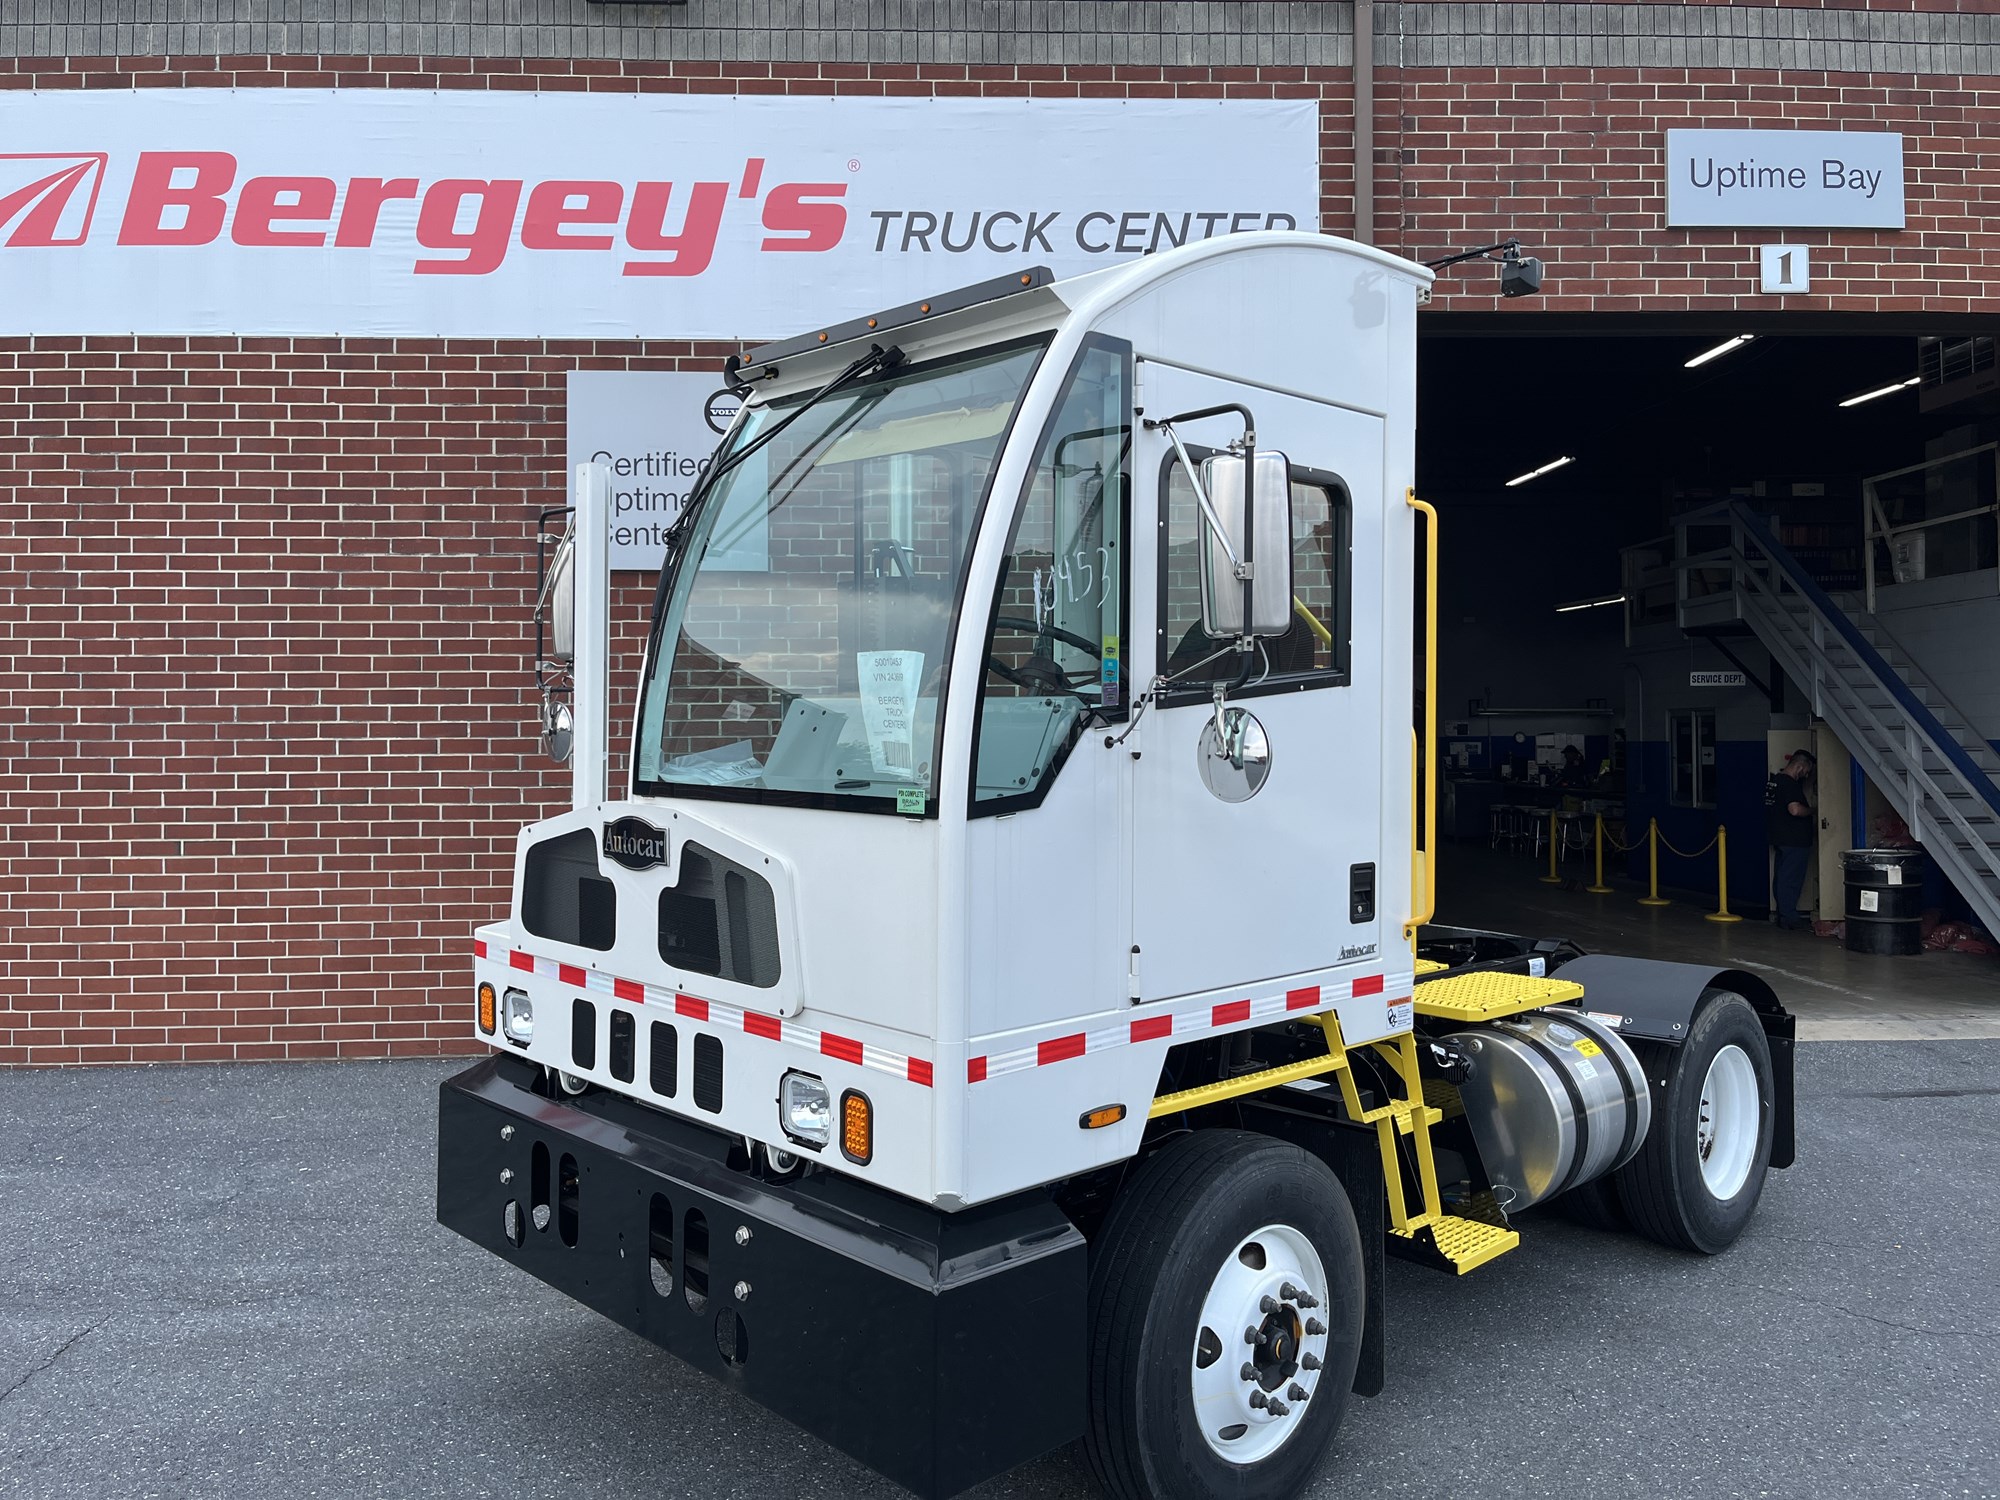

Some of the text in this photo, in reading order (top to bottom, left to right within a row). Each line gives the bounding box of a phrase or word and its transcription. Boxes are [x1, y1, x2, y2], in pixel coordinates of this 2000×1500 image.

[1690, 157, 1882, 199] Uptime Bay
[118, 152, 847, 276] Bergey's
[871, 211, 1060, 253] TRUCK
[1777, 251, 1792, 284] 1
[873, 672, 887, 682] VIN
[1691, 674, 1745, 684] SERVICE DEPT.
[604, 827, 664, 858] Autocar
[1337, 943, 1377, 961] Autocar
